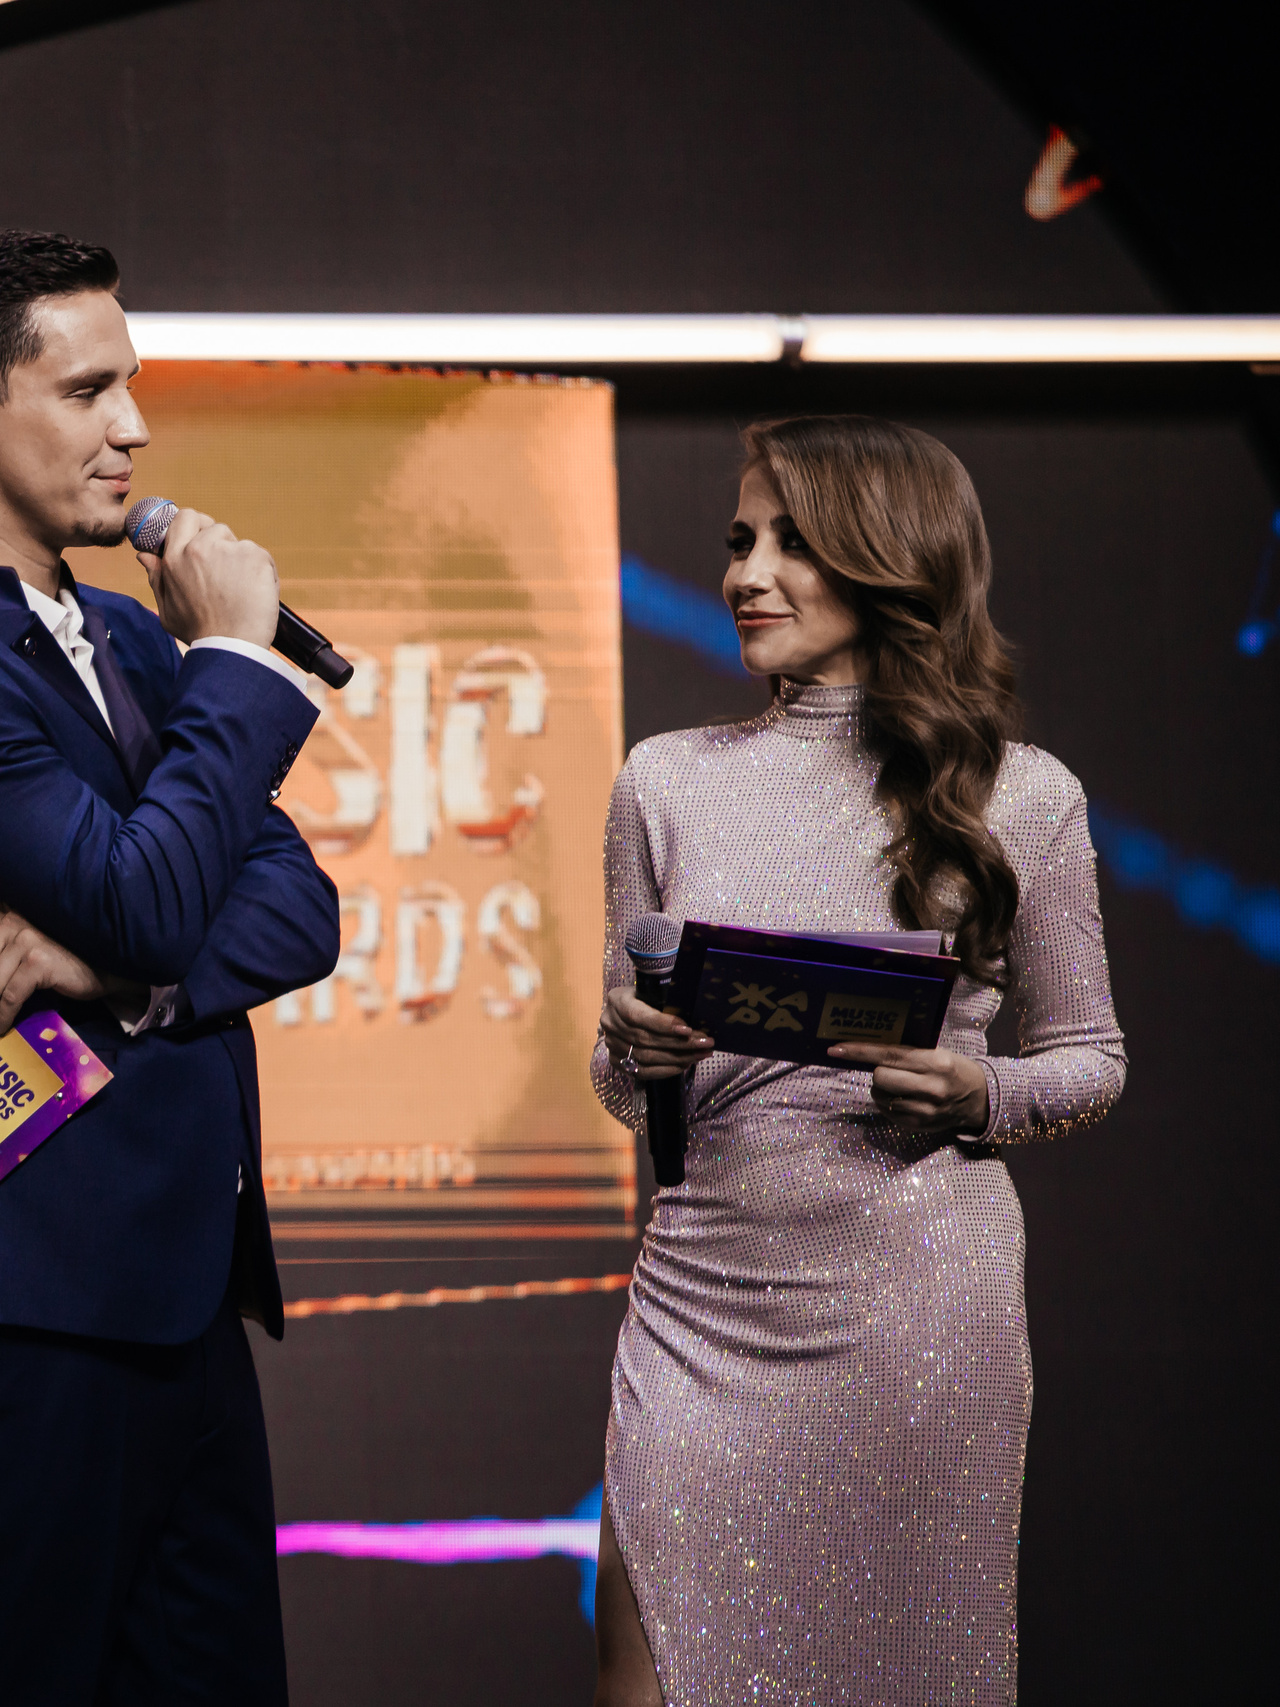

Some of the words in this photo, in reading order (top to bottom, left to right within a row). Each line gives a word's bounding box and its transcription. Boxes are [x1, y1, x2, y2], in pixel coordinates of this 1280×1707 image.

[292, 642, 548, 856] SIC
[275, 879, 544, 1026] RDS
[830, 1005, 899, 1023] MUSIC
[830, 1018, 895, 1032] AWARDS
